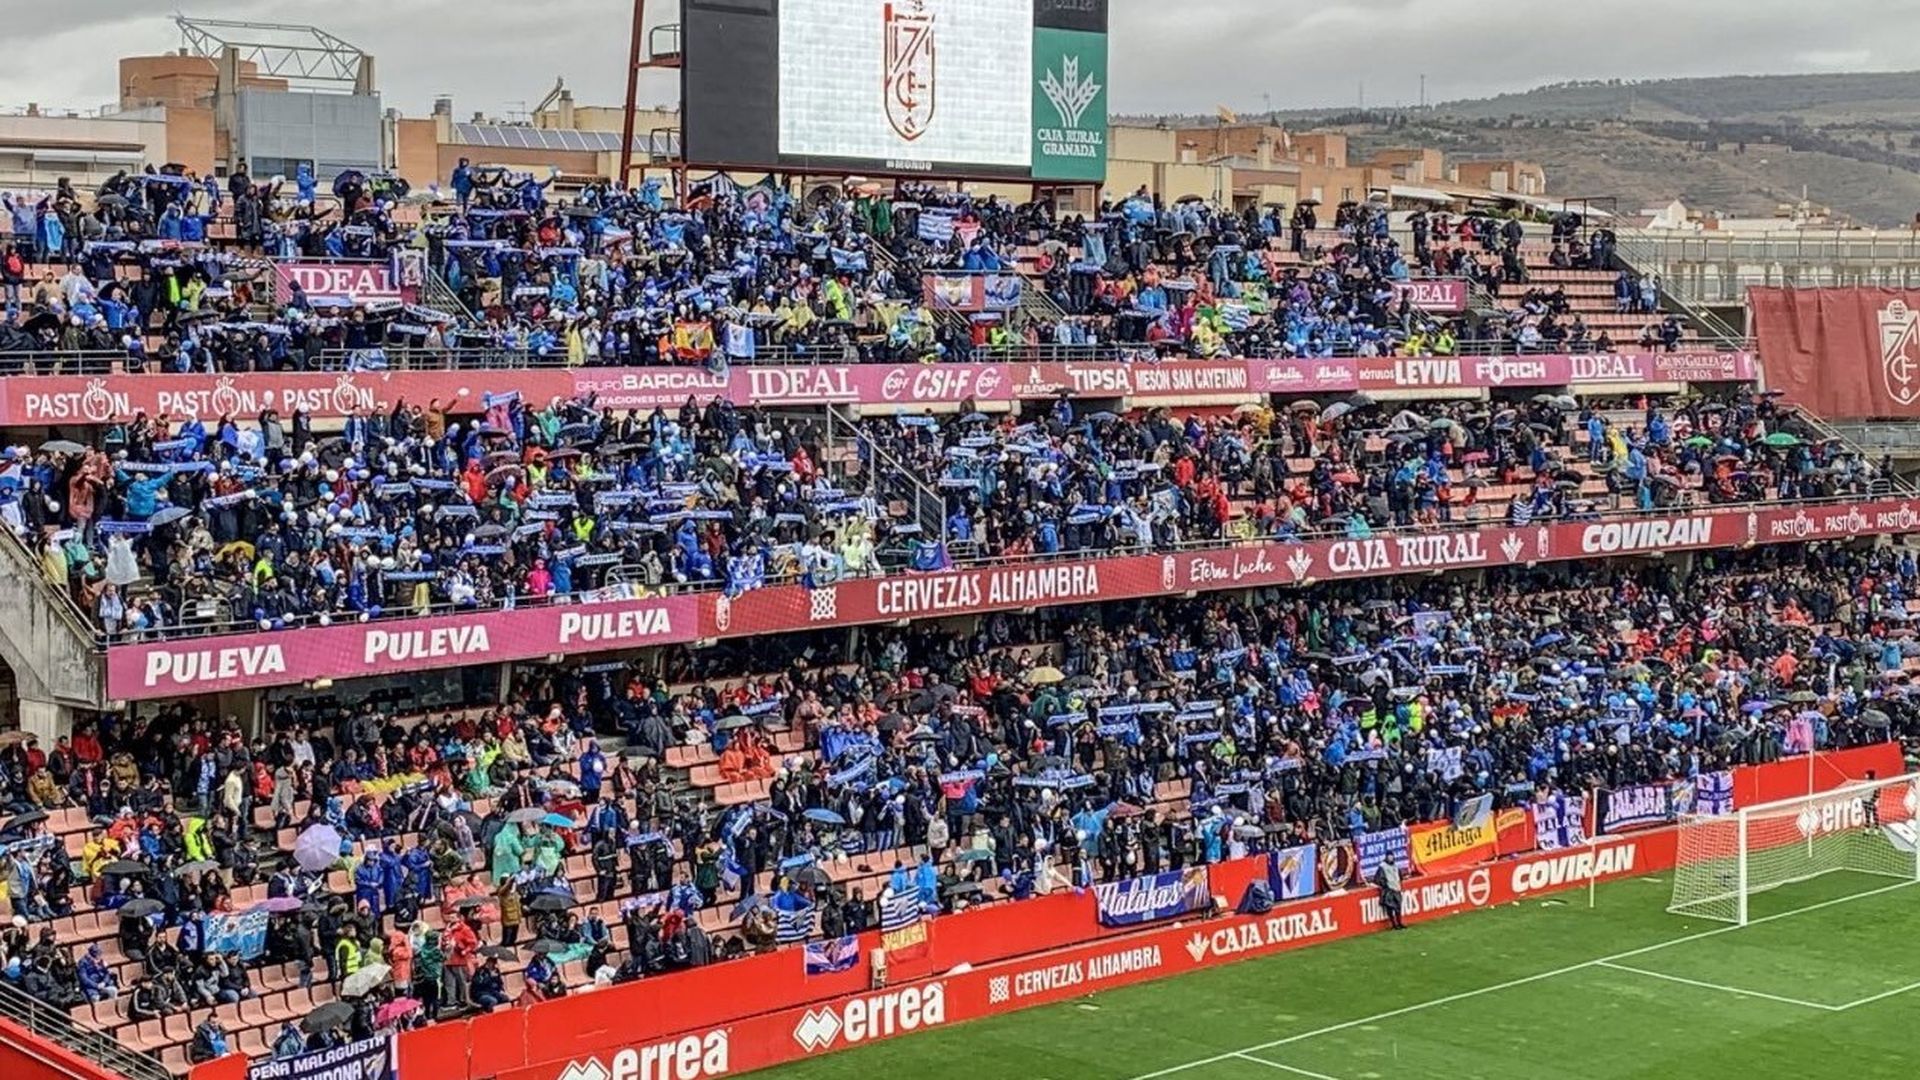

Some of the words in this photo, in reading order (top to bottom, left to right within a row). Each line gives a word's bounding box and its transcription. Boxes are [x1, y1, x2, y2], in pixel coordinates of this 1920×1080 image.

[1038, 129, 1063, 142] CAJA
[1066, 130, 1102, 144] RURAL
[1042, 143, 1096, 157] GRANADA
[290, 268, 401, 294] IDEAL
[747, 367, 859, 398] IDEAL
[1069, 369, 1130, 391] TIPSA
[1172, 369, 1194, 390] SAN
[1195, 367, 1247, 389] CAYETANO
[1395, 359, 1462, 384] LEYVA
[1569, 354, 1643, 378] IDEAL
[576, 380, 622, 392] GRUPO
[1582, 517, 1712, 552] COVIRAN
[1233, 549, 1276, 580] Lucha
[1328, 539, 1391, 573] CAJA
[1399, 532, 1487, 567] RURAL
[877, 572, 982, 615] CERVEZAS
[989, 564, 1099, 603] ALHAMBRA
[559, 608, 671, 643] PULEVA
[364, 625, 490, 664] PULEVA
[144, 644, 286, 686] PULEVA
[1511, 843, 1635, 892] COVIRAN
[1422, 879, 1465, 912] DIGASA
[1211, 922, 1264, 956] CAJA
[1266, 907, 1338, 945] RURAL
[1015, 963, 1083, 997] CERVEZAS
[1088, 944, 1162, 981] ALHAMBRA
[250, 1060, 291, 1080] PEÑA
[294, 1036, 386, 1074] MALAGUISTA
